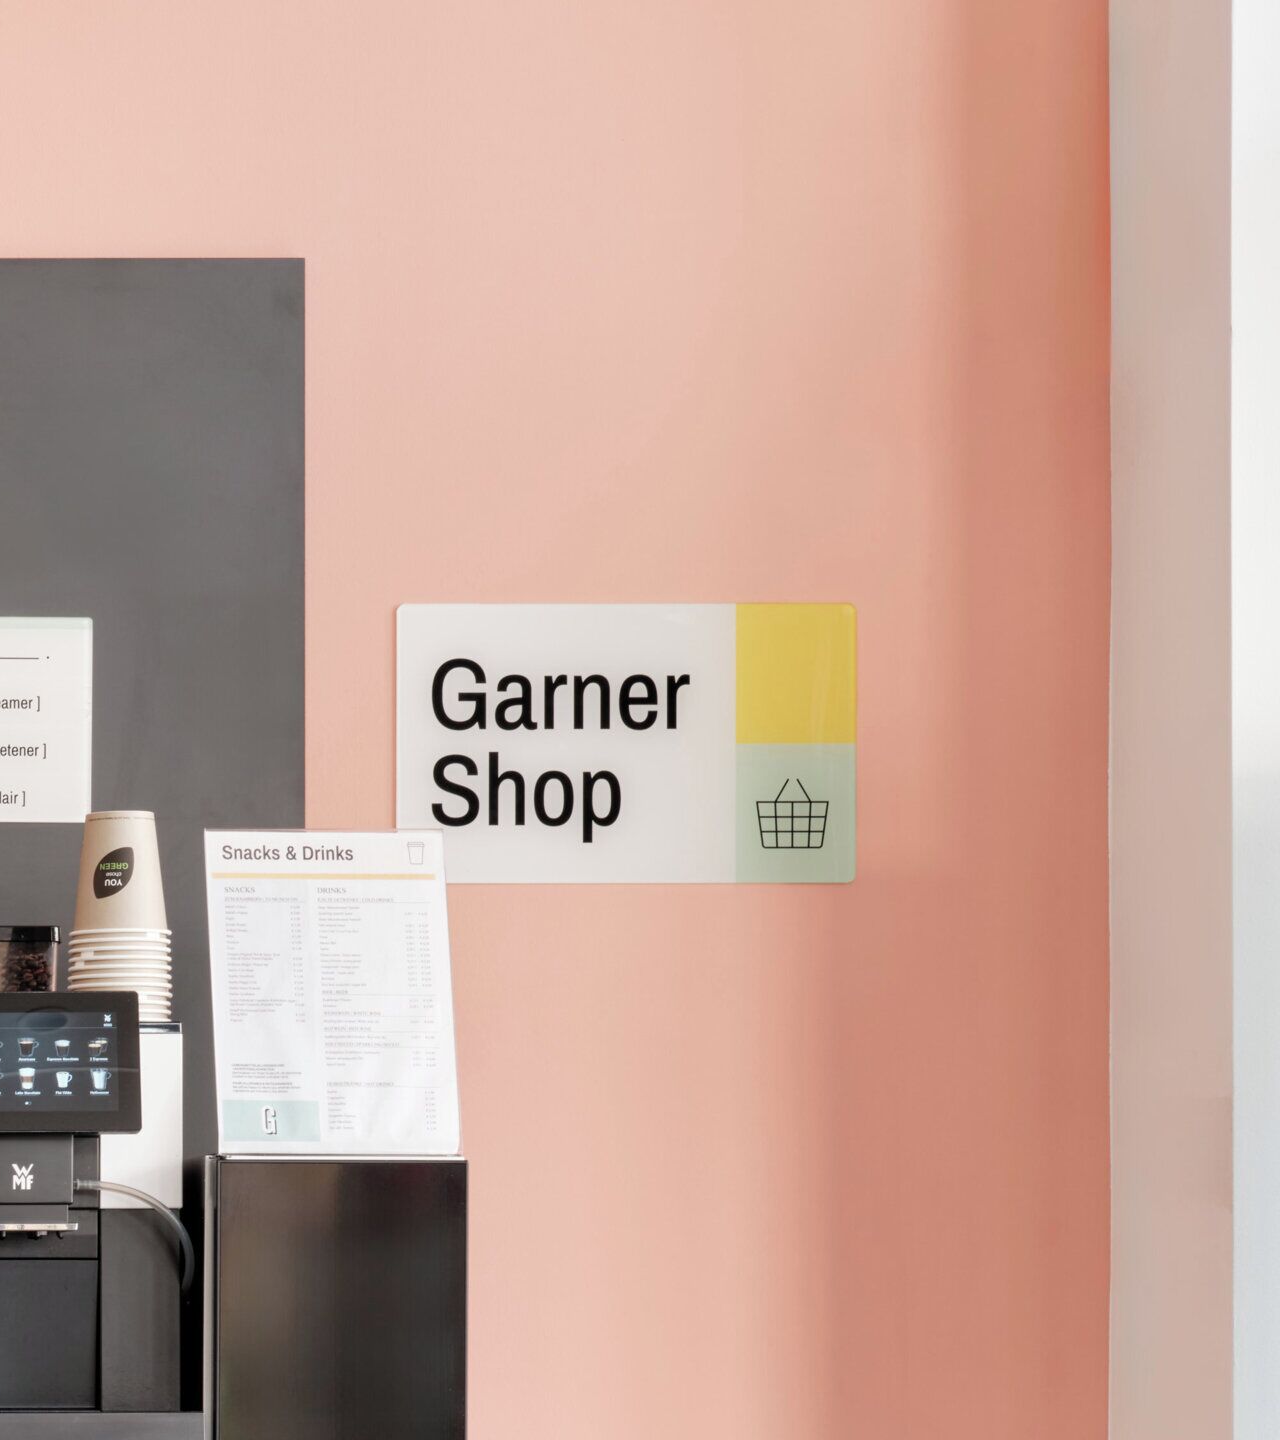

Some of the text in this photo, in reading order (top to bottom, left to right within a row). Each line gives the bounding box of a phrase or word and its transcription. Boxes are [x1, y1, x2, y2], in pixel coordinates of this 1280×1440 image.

[431, 658, 690, 730] Garner
[431, 751, 621, 843] Shop
[100, 862, 128, 870] GREEN
[222, 845, 354, 861] Snacks & Drinks
